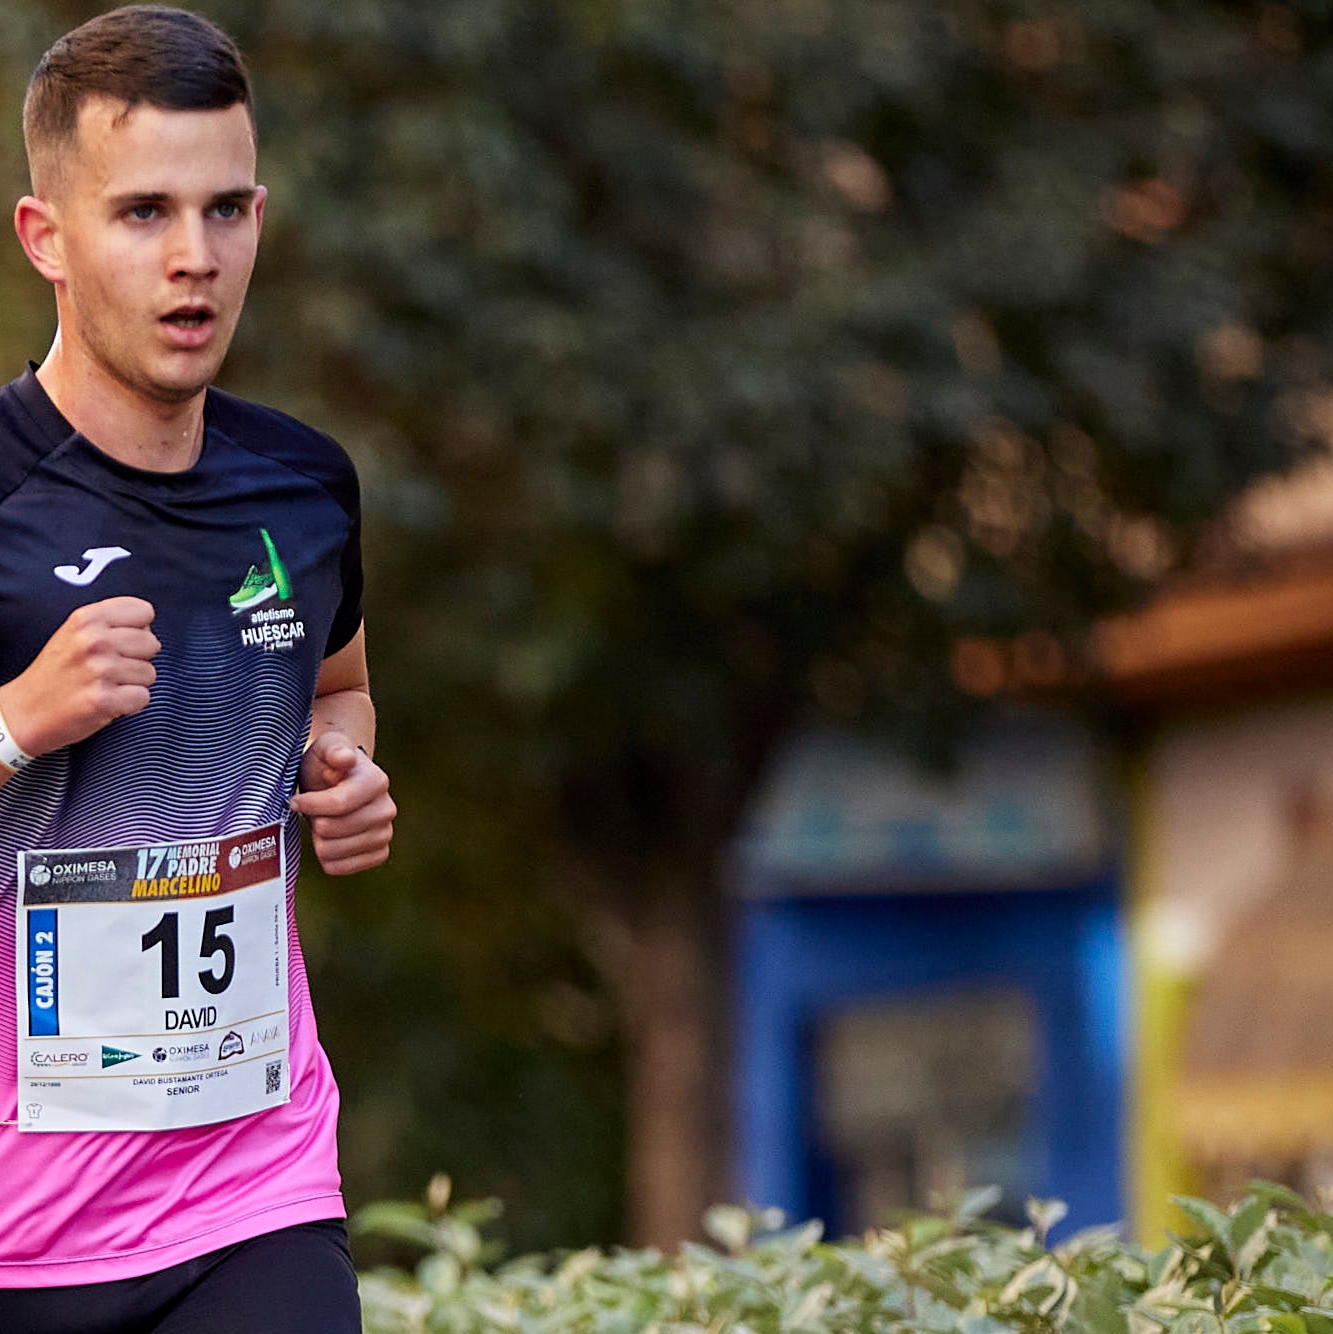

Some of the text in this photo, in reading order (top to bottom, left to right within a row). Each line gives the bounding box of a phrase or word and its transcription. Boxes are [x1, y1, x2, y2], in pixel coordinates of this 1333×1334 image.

[251, 608, 295, 623] atletismo
[241, 622, 306, 646] HUÉSCAR
[241, 836, 277, 856] OXIMESA
[53, 860, 117, 875] OXIMESA
[136, 842, 220, 880] 17 MEMORIAL
[166, 856, 218, 879] PADRE
[86, 872, 117, 882] GASES
[131, 873, 222, 898] MARCELINO
[141, 904, 235, 999] 15
[31, 930, 55, 1010] CAJÓN 2
[164, 1006, 218, 1031] DAVID
[34, 1053, 88, 1063] CALERO
[169, 1043, 210, 1055] OXIMESA
[133, 1069, 229, 1086] DAVID BUSTAMANTE ORTEGA
[166, 1085, 200, 1096] SENIOR
